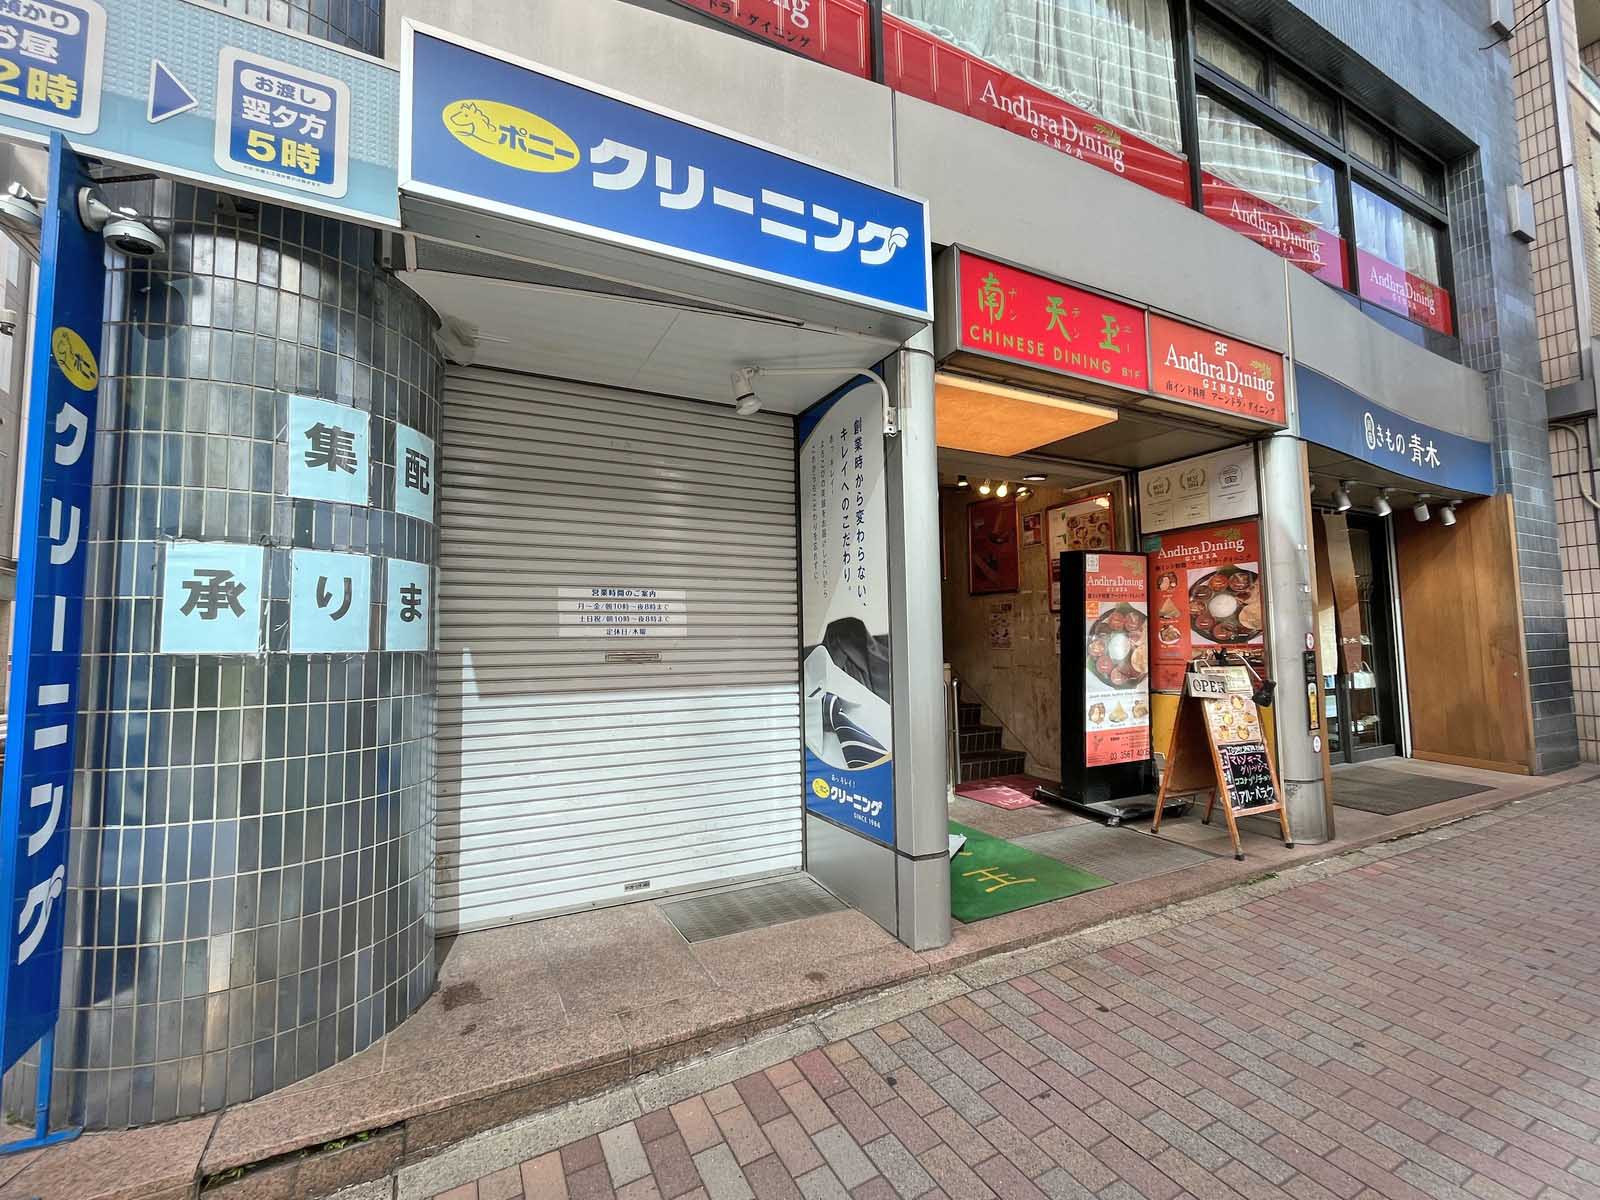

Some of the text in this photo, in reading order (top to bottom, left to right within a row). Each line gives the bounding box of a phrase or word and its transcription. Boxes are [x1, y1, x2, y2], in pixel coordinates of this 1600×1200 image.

[255, 76, 316, 104] お渡し
[241, 96, 327, 139] 翌夕方
[246, 129, 320, 175] 5時
[499, 115, 574, 160] ポニー
[1031, 128, 1083, 159] GINZA
[590, 138, 910, 265] クリーニング
[1261, 233, 1294, 255] GINZA
[969, 324, 1046, 357] CHINESE
[1053, 346, 1112, 374] DINING
[1215, 340, 1228, 357] 2F
[1202, 378, 1243, 398] GINZA
[592, 588, 656, 598] 営業時間のご案内
[18, 402, 88, 966] クリーニング
[1193, 678, 1226, 693] OPEN
[831, 786, 883, 816] クリーニング
